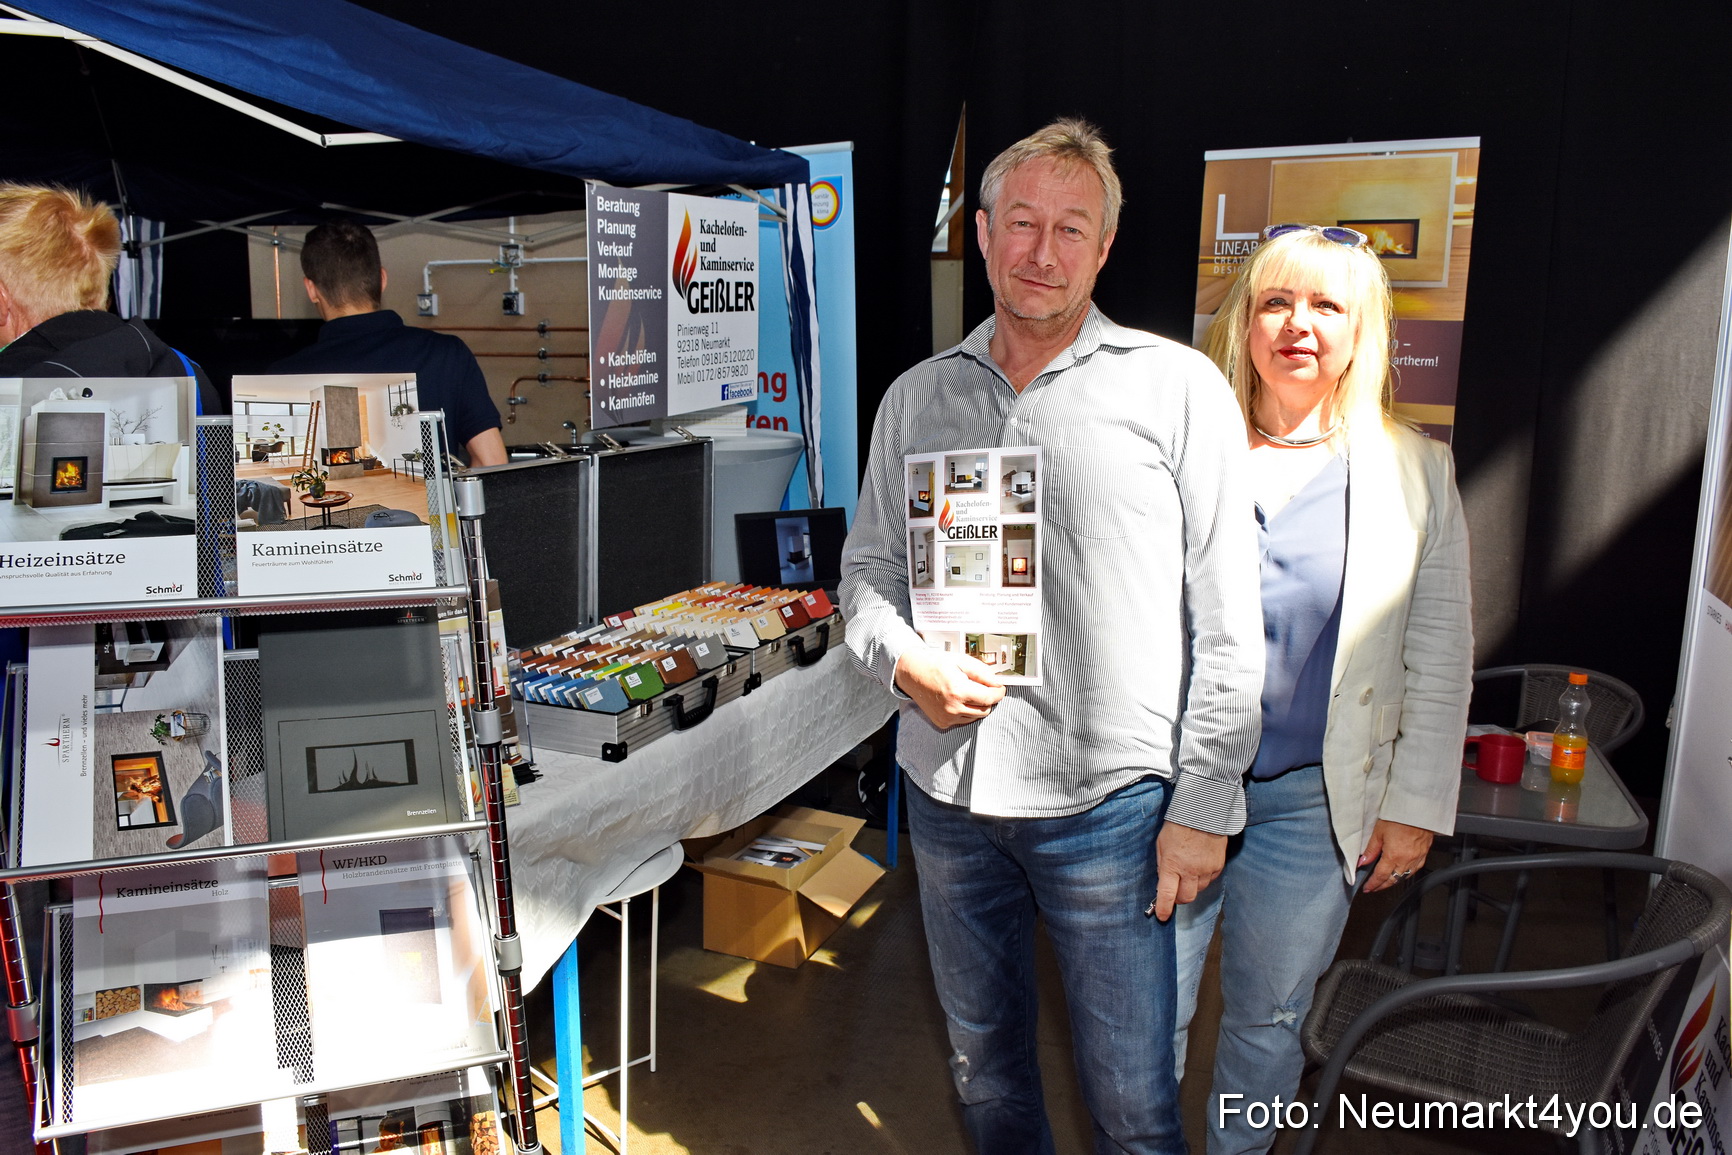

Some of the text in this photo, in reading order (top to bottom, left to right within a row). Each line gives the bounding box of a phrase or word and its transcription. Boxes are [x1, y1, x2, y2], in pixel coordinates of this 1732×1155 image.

[596, 196, 640, 217] Beratung
[597, 219, 636, 238] Planung
[699, 218, 748, 237] Kachelofen-
[597, 241, 633, 257] Verkauf
[700, 239, 716, 253] und
[700, 256, 755, 272] Kaminservice
[598, 263, 637, 282] Montage
[598, 286, 662, 301] Kundenservice
[687, 278, 755, 314] GEißLER
[677, 321, 719, 337] Pinienweg 11
[677, 337, 731, 353] 92318 Neumarkt
[608, 349, 656, 367] Kachelöfen
[677, 348, 755, 369] Telefon 09181/5120220
[1391, 355, 1439, 367] artherm!
[608, 371, 659, 389] Heizkamine
[677, 364, 749, 385] Mobil 0172/8579820
[729, 386, 753, 398] facebook
[608, 393, 655, 411] Kaminöfen
[947, 524, 998, 539] GEißLER
[252, 540, 383, 557] Kamineinsätze
[0, 551, 126, 569] Heizeinsätze
[82, 569, 113, 577] Erfahrung
[388, 573, 423, 582] Schmid
[146, 584, 183, 594] Schmid
[62, 717, 71, 763] SPARTHERM
[80, 744, 88, 777] Brennzellen
[407, 808, 437, 816] Brennzellen
[332, 855, 388, 870] WF/HKD
[409, 864, 423, 872] mit
[424, 860, 463, 871] Frontplatte
[116, 879, 219, 899] Kamineinsätze
[211, 889, 229, 897] Holz
